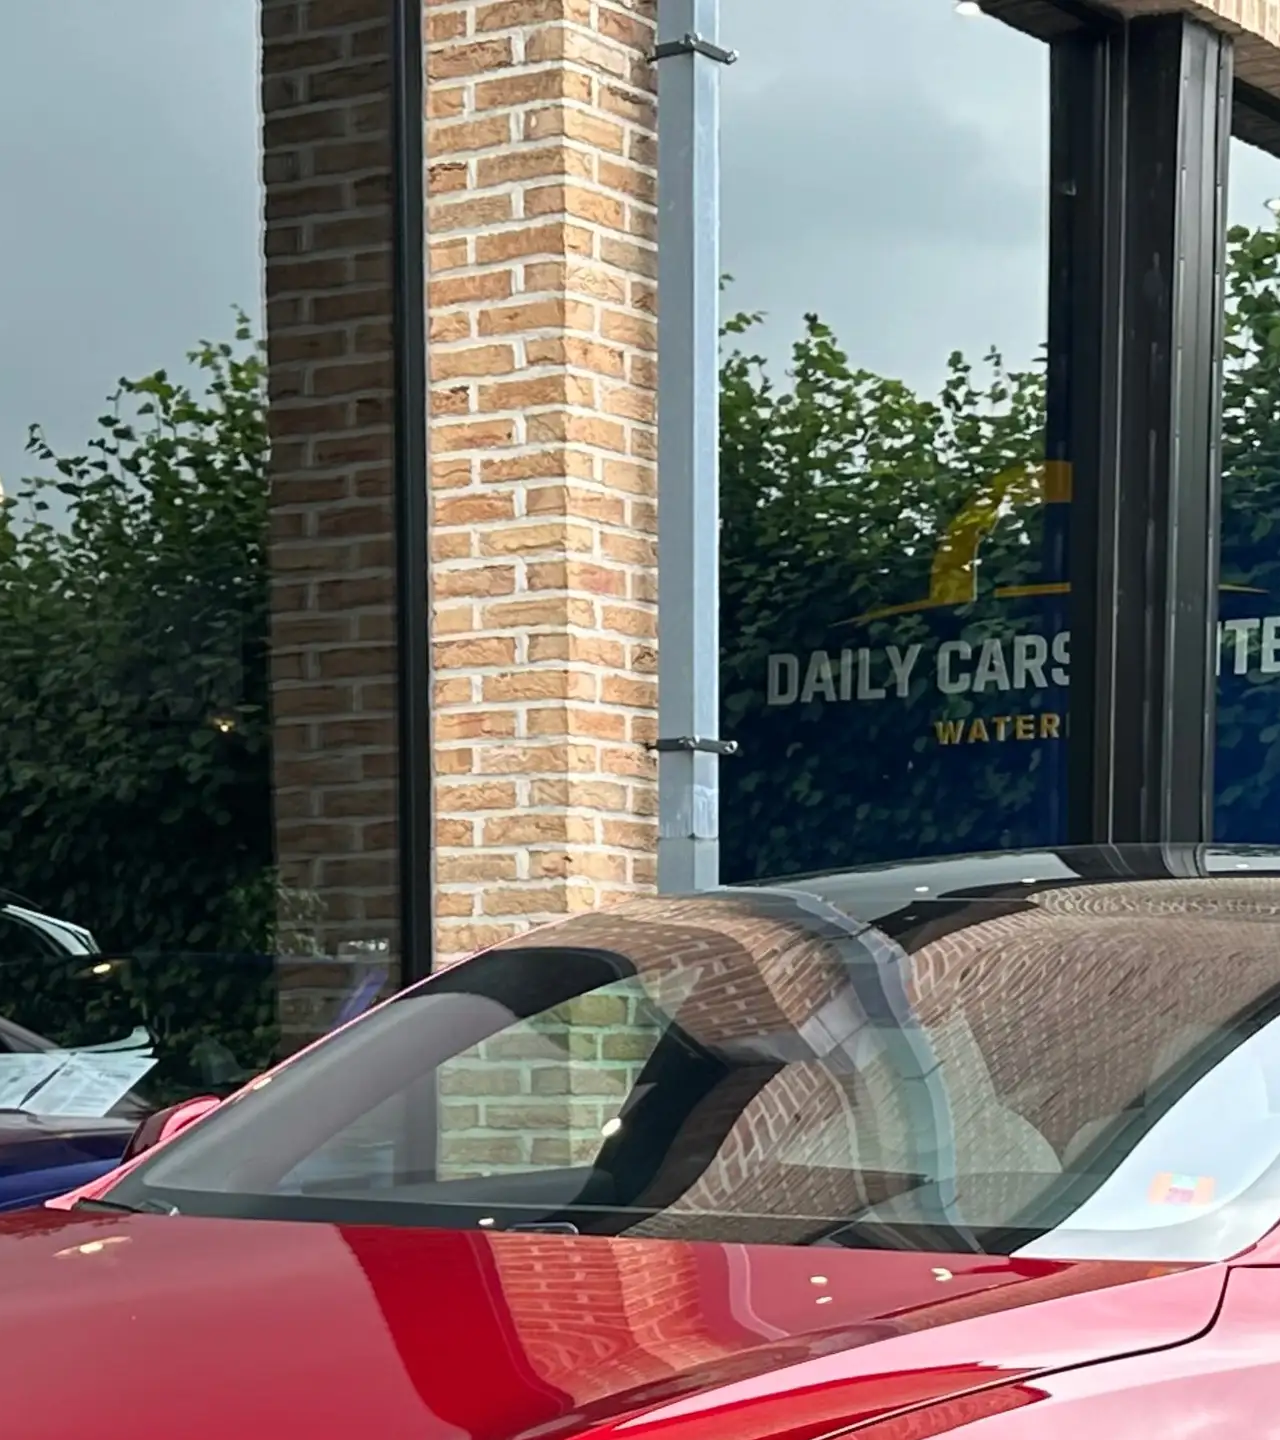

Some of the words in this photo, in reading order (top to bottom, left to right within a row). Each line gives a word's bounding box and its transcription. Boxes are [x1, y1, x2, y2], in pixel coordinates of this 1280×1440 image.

[766, 641, 923, 706] DAILY
[937, 631, 1070, 694] CARS
[934, 712, 1069, 745] WATER
